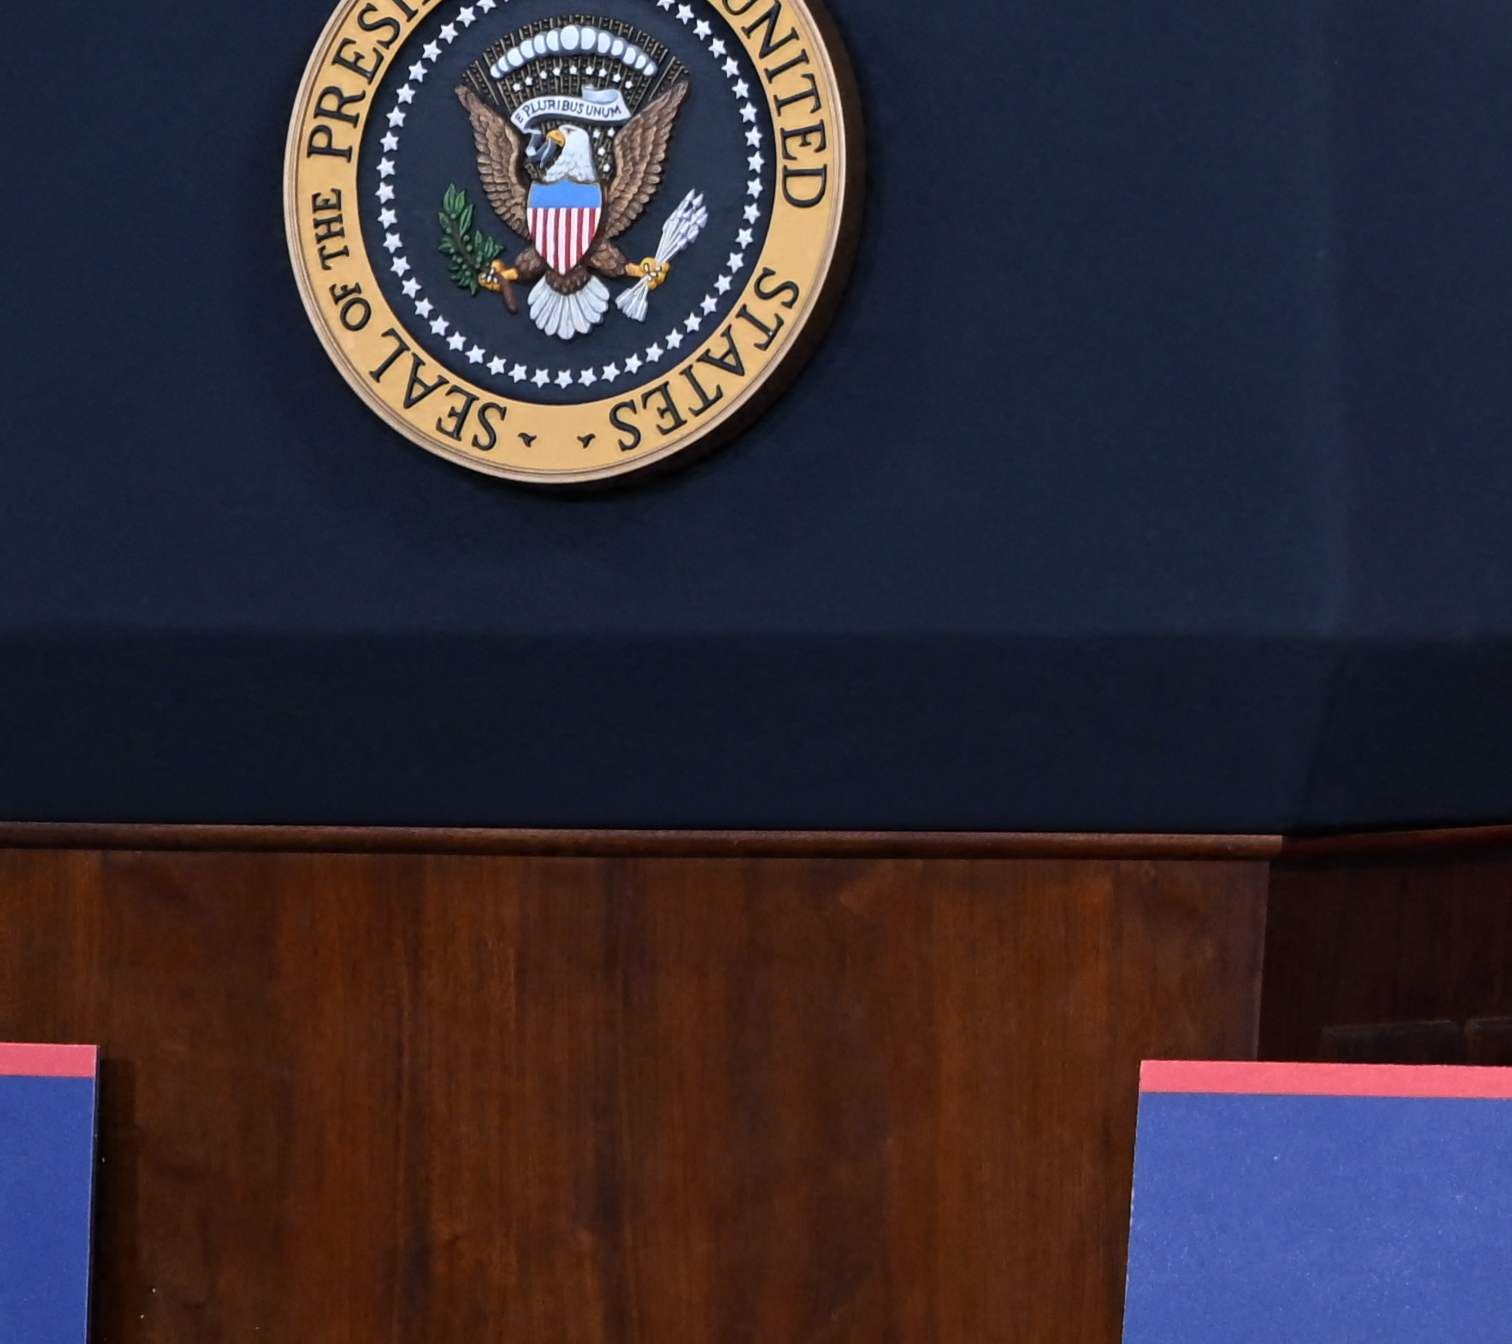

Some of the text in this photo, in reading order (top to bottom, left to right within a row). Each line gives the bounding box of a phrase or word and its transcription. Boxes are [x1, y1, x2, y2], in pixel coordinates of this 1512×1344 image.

[522, 98, 584, 118] PLURIBUS
[585, 104, 622, 119] UNUM
[311, 187, 351, 270] THE
[328, 281, 372, 332] OF
[369, 327, 508, 451] SEAL
[608, 266, 800, 452] STATES
